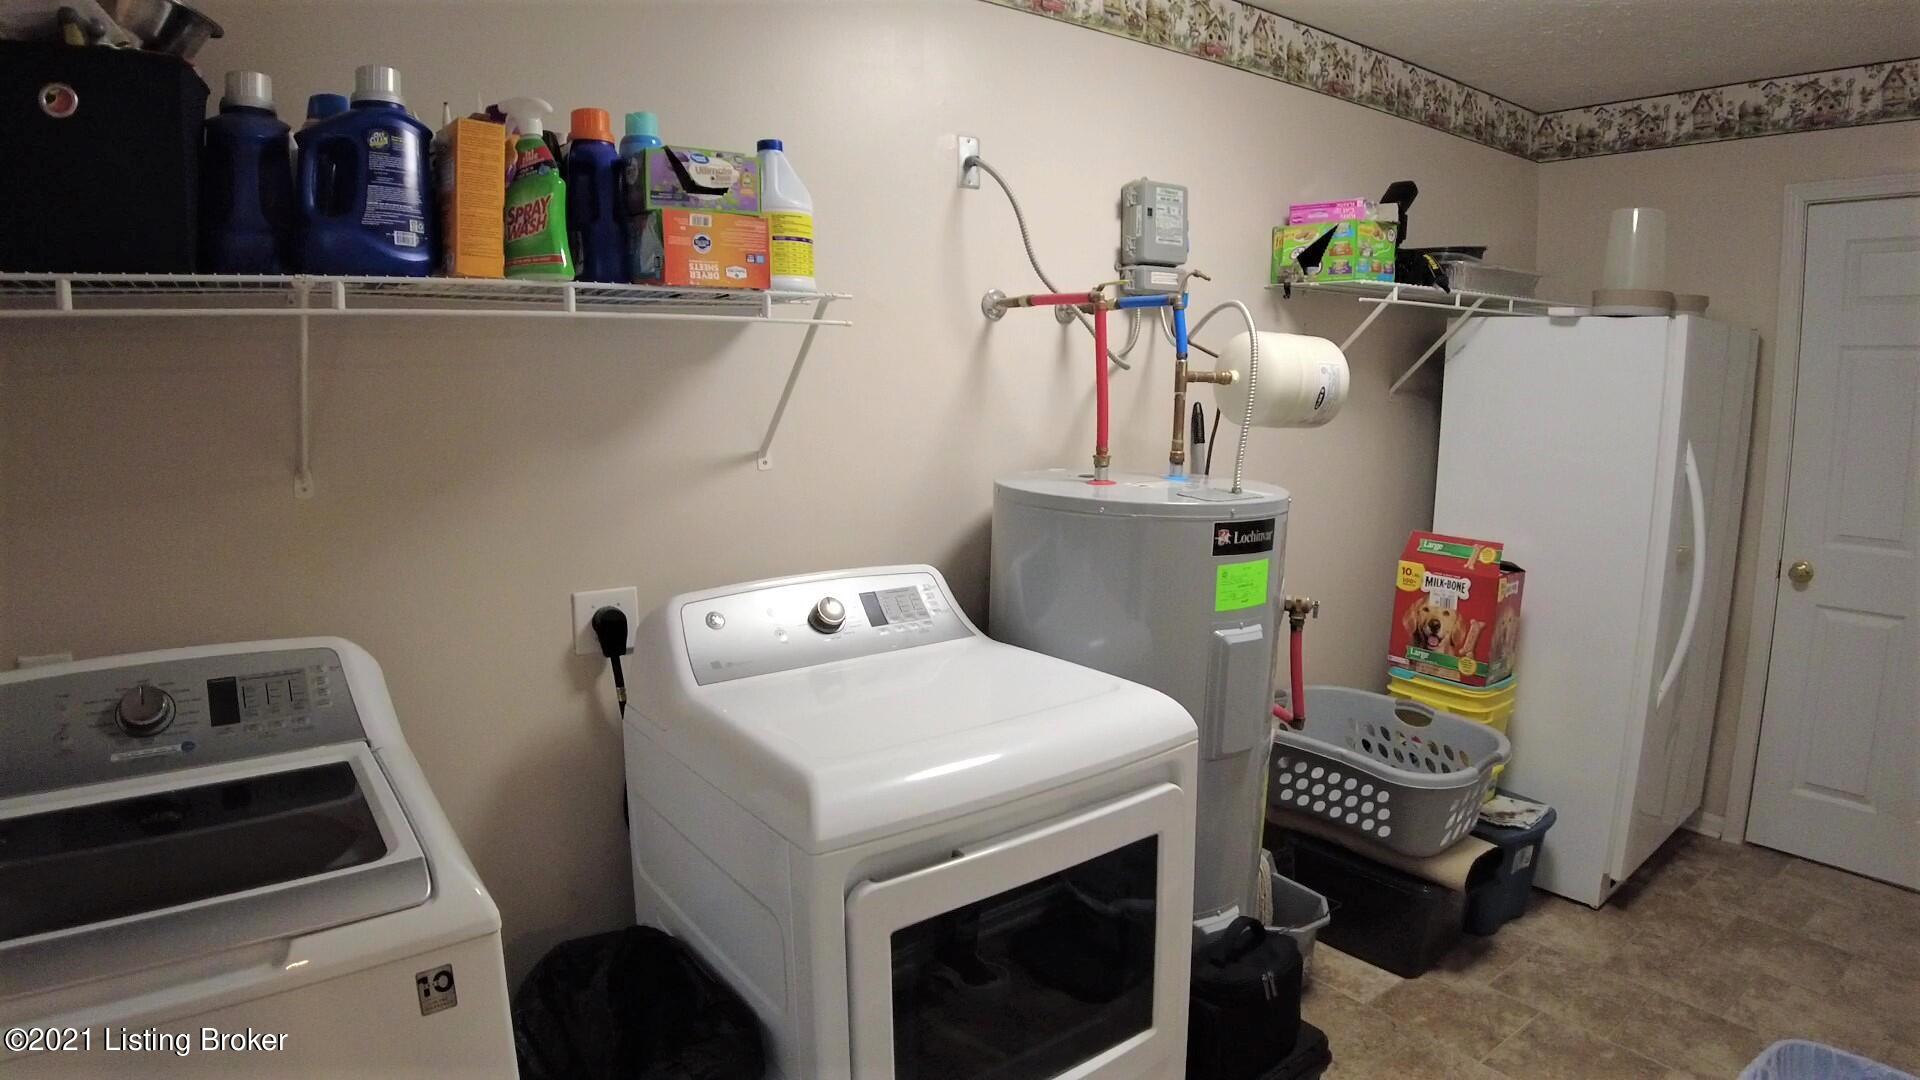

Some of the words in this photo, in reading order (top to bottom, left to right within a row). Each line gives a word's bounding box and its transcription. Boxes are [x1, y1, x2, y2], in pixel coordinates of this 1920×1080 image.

[507, 194, 552, 225] SPRAY
[507, 214, 548, 240] WASH
[689, 262, 720, 271] SHEETS
[689, 270, 720, 280] DRYER
[1423, 540, 1444, 551] Large
[1424, 576, 1467, 594] MILK-BONE
[1410, 647, 1430, 659] Large
